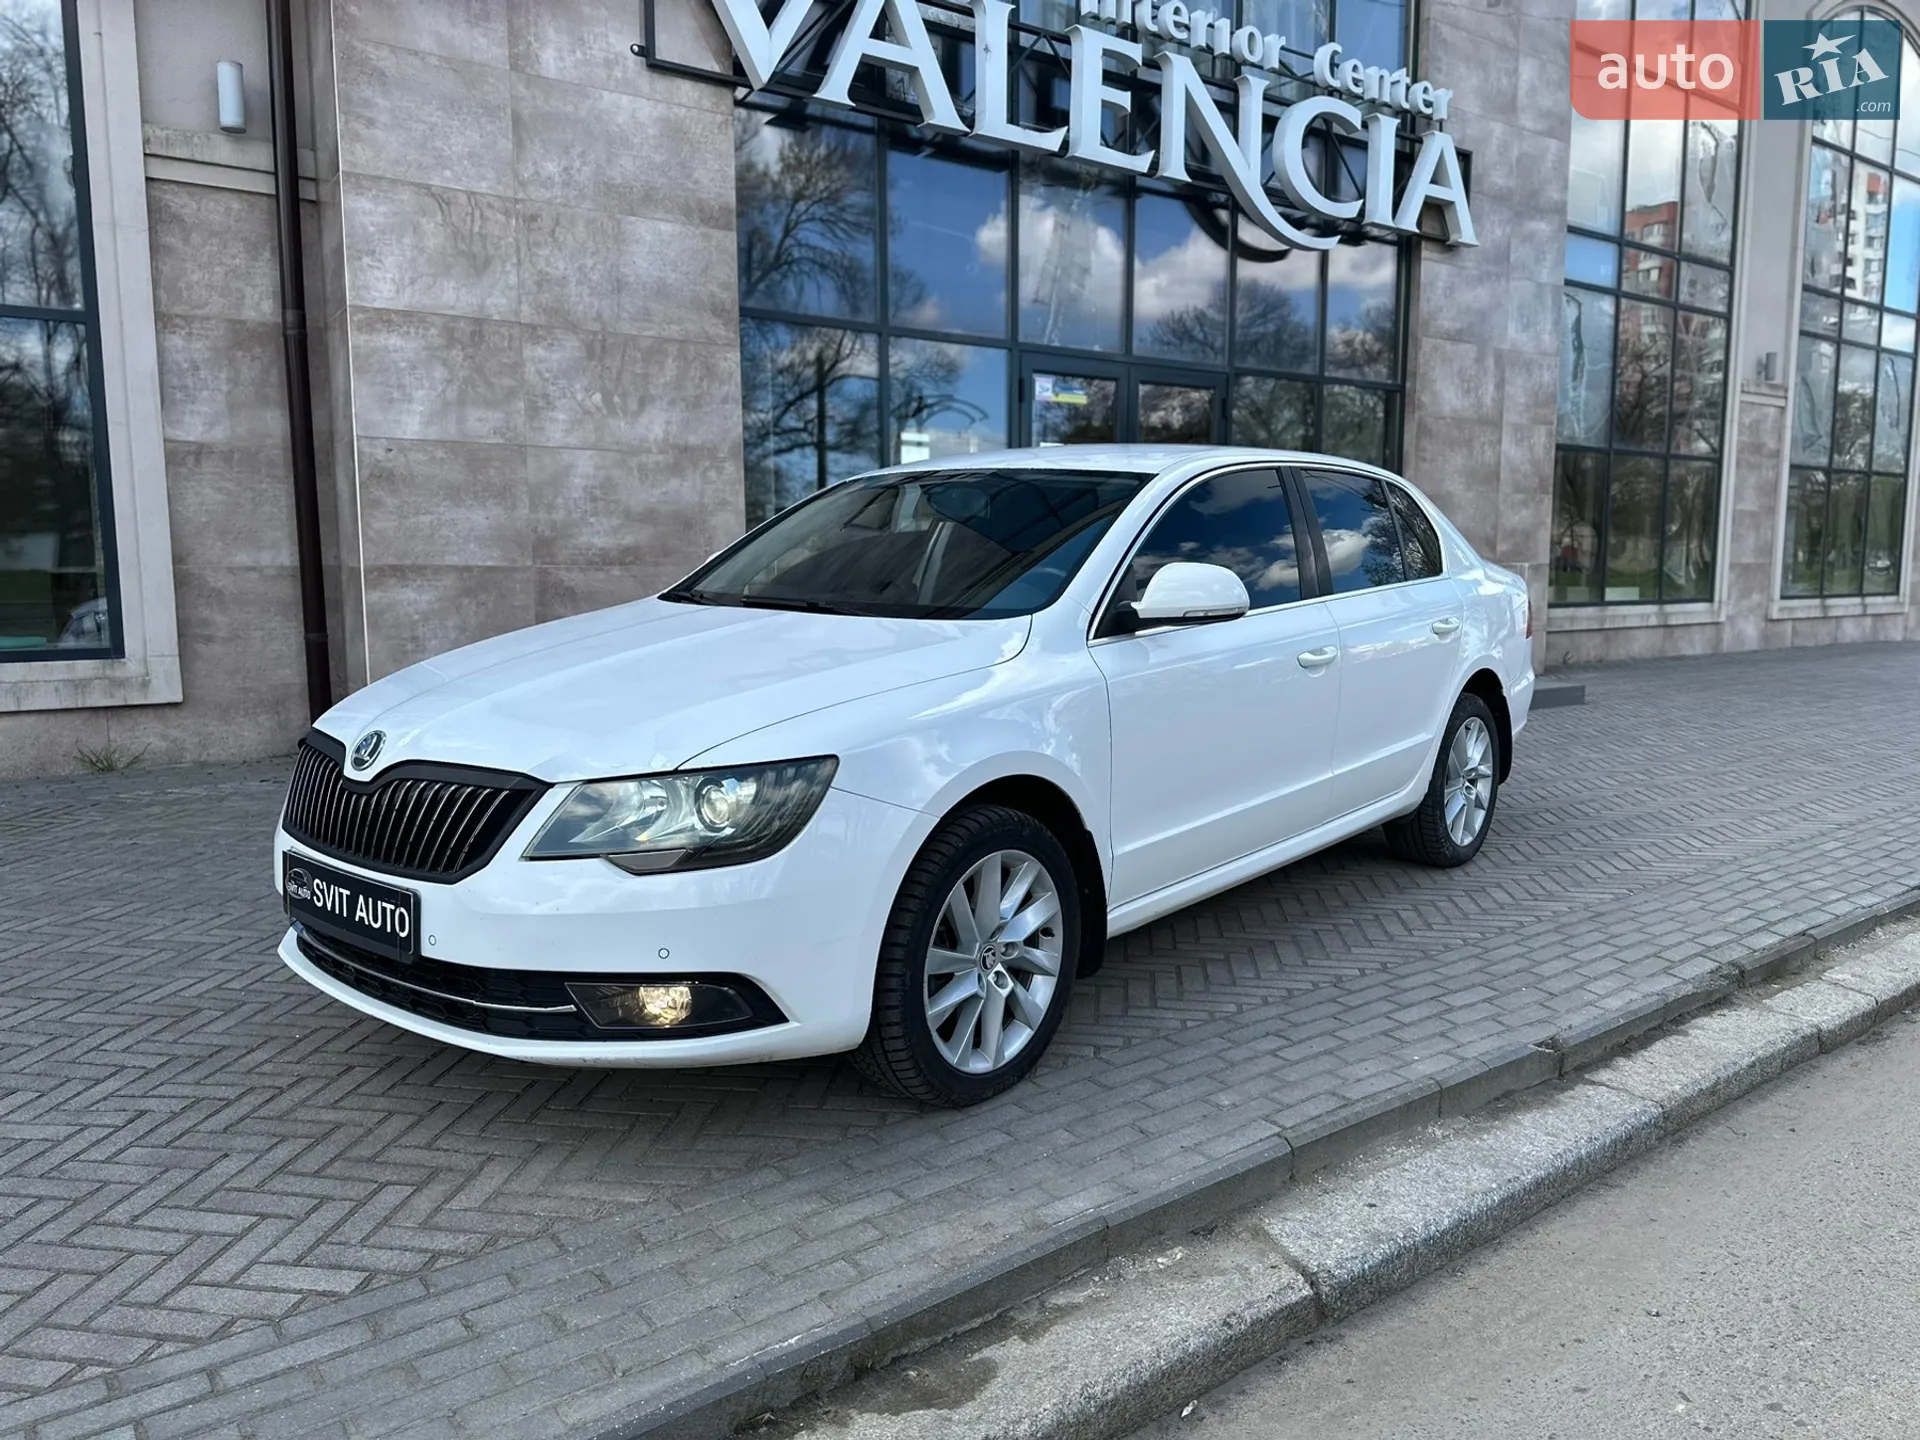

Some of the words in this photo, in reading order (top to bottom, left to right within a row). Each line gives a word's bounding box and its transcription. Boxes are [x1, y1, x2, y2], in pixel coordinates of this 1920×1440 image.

[1314, 42, 1452, 121] Center
[713, 0, 1481, 252] VALENCIA
[313, 878, 350, 918] SVIT
[355, 894, 409, 938] AUTO
